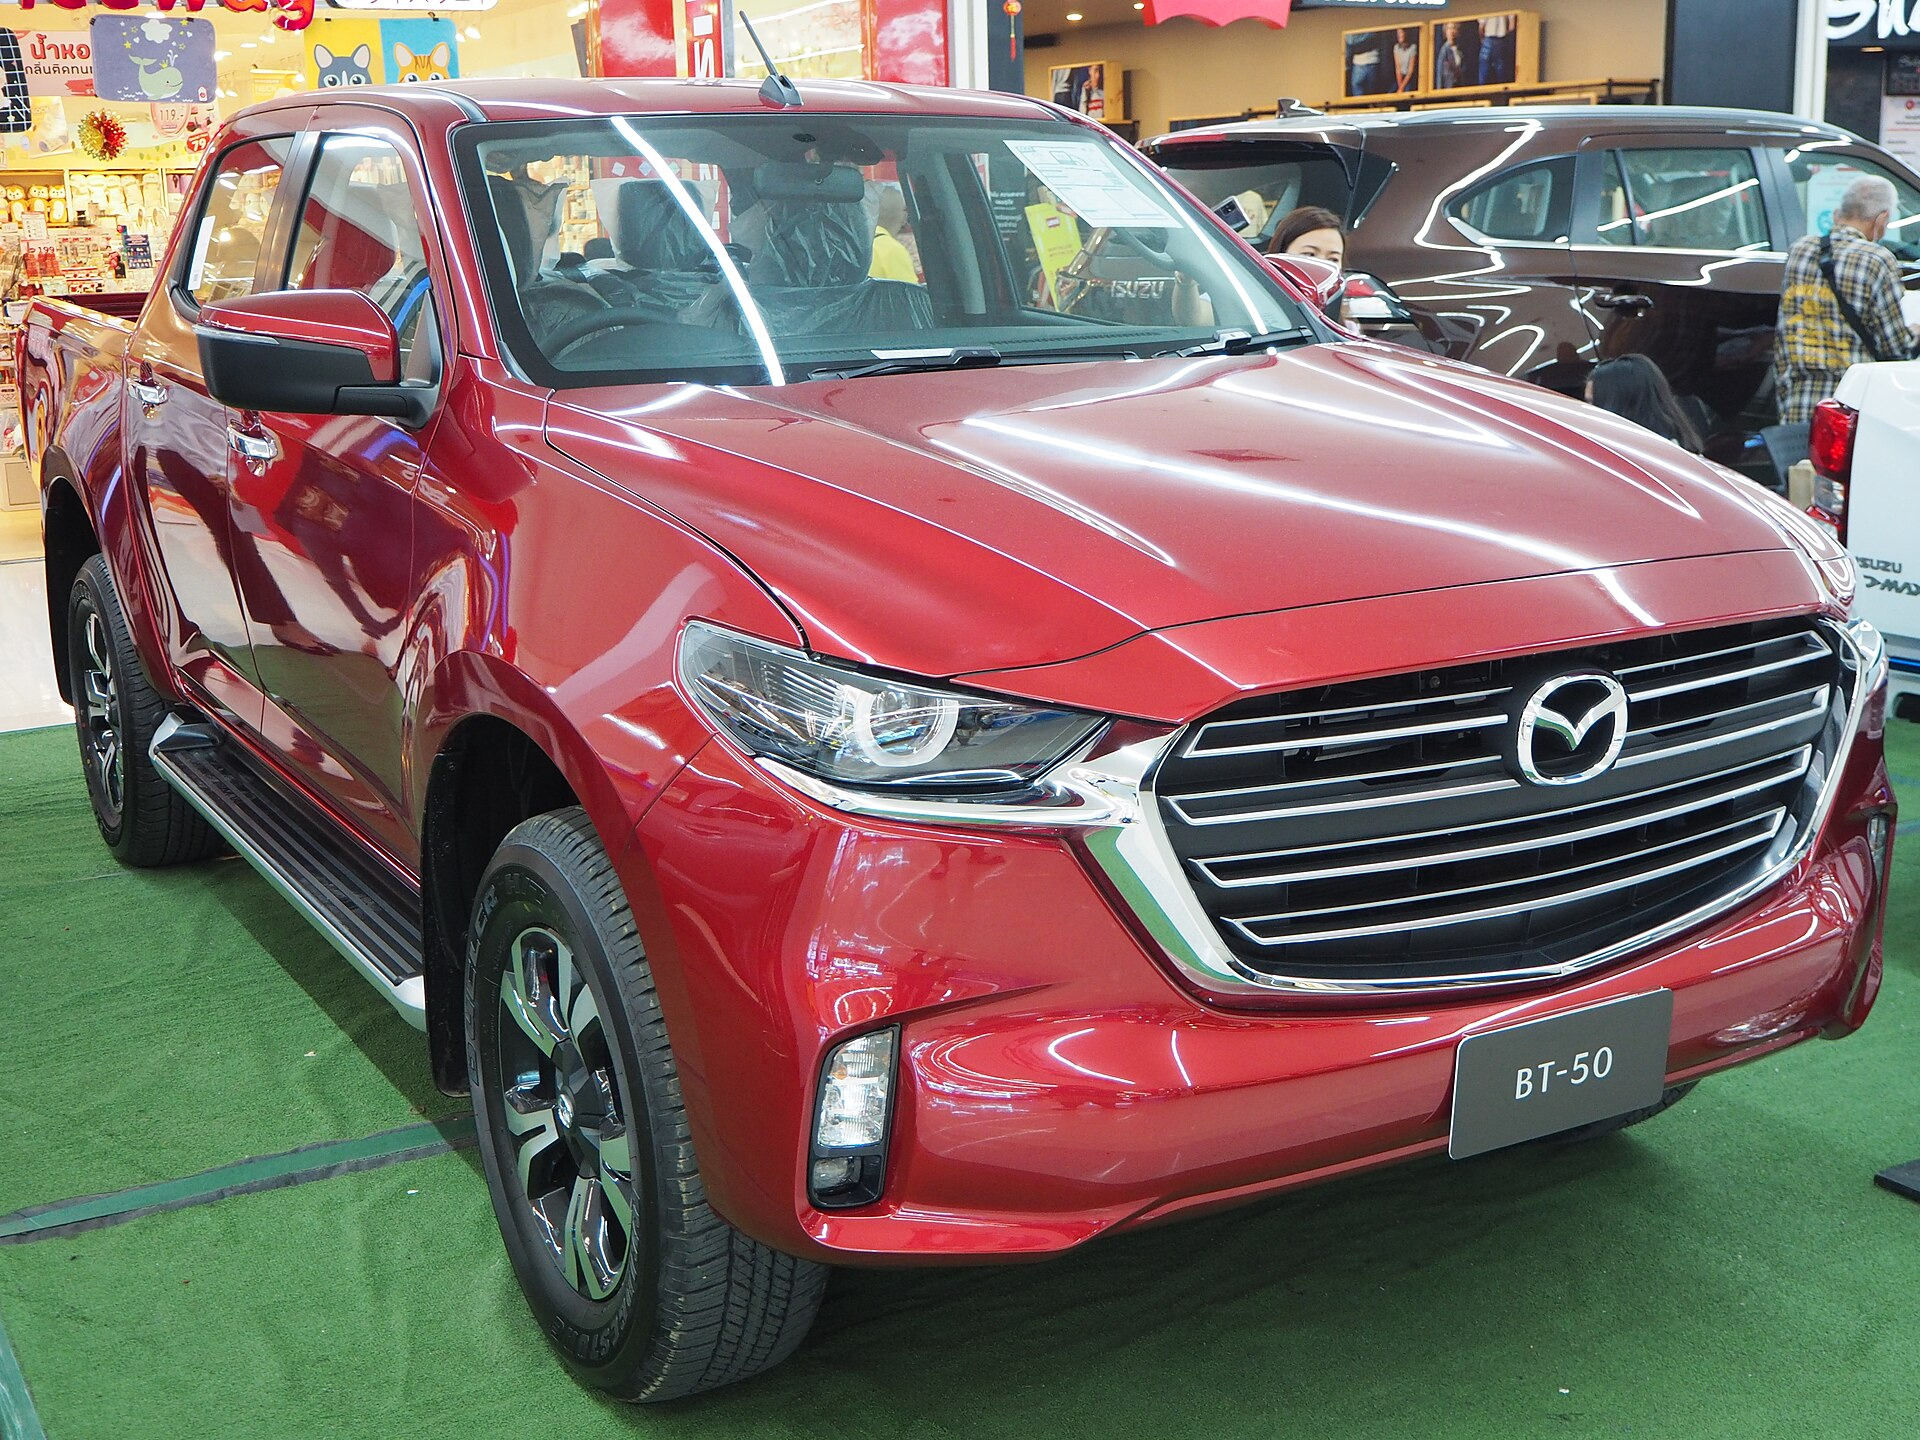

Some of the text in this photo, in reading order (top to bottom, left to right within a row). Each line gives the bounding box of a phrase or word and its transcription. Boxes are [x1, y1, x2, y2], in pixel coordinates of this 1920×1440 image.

[191, 137, 207, 152] 79
[1111, 280, 1165, 299] ISUZU
[1515, 1046, 1613, 1100] BT-50
